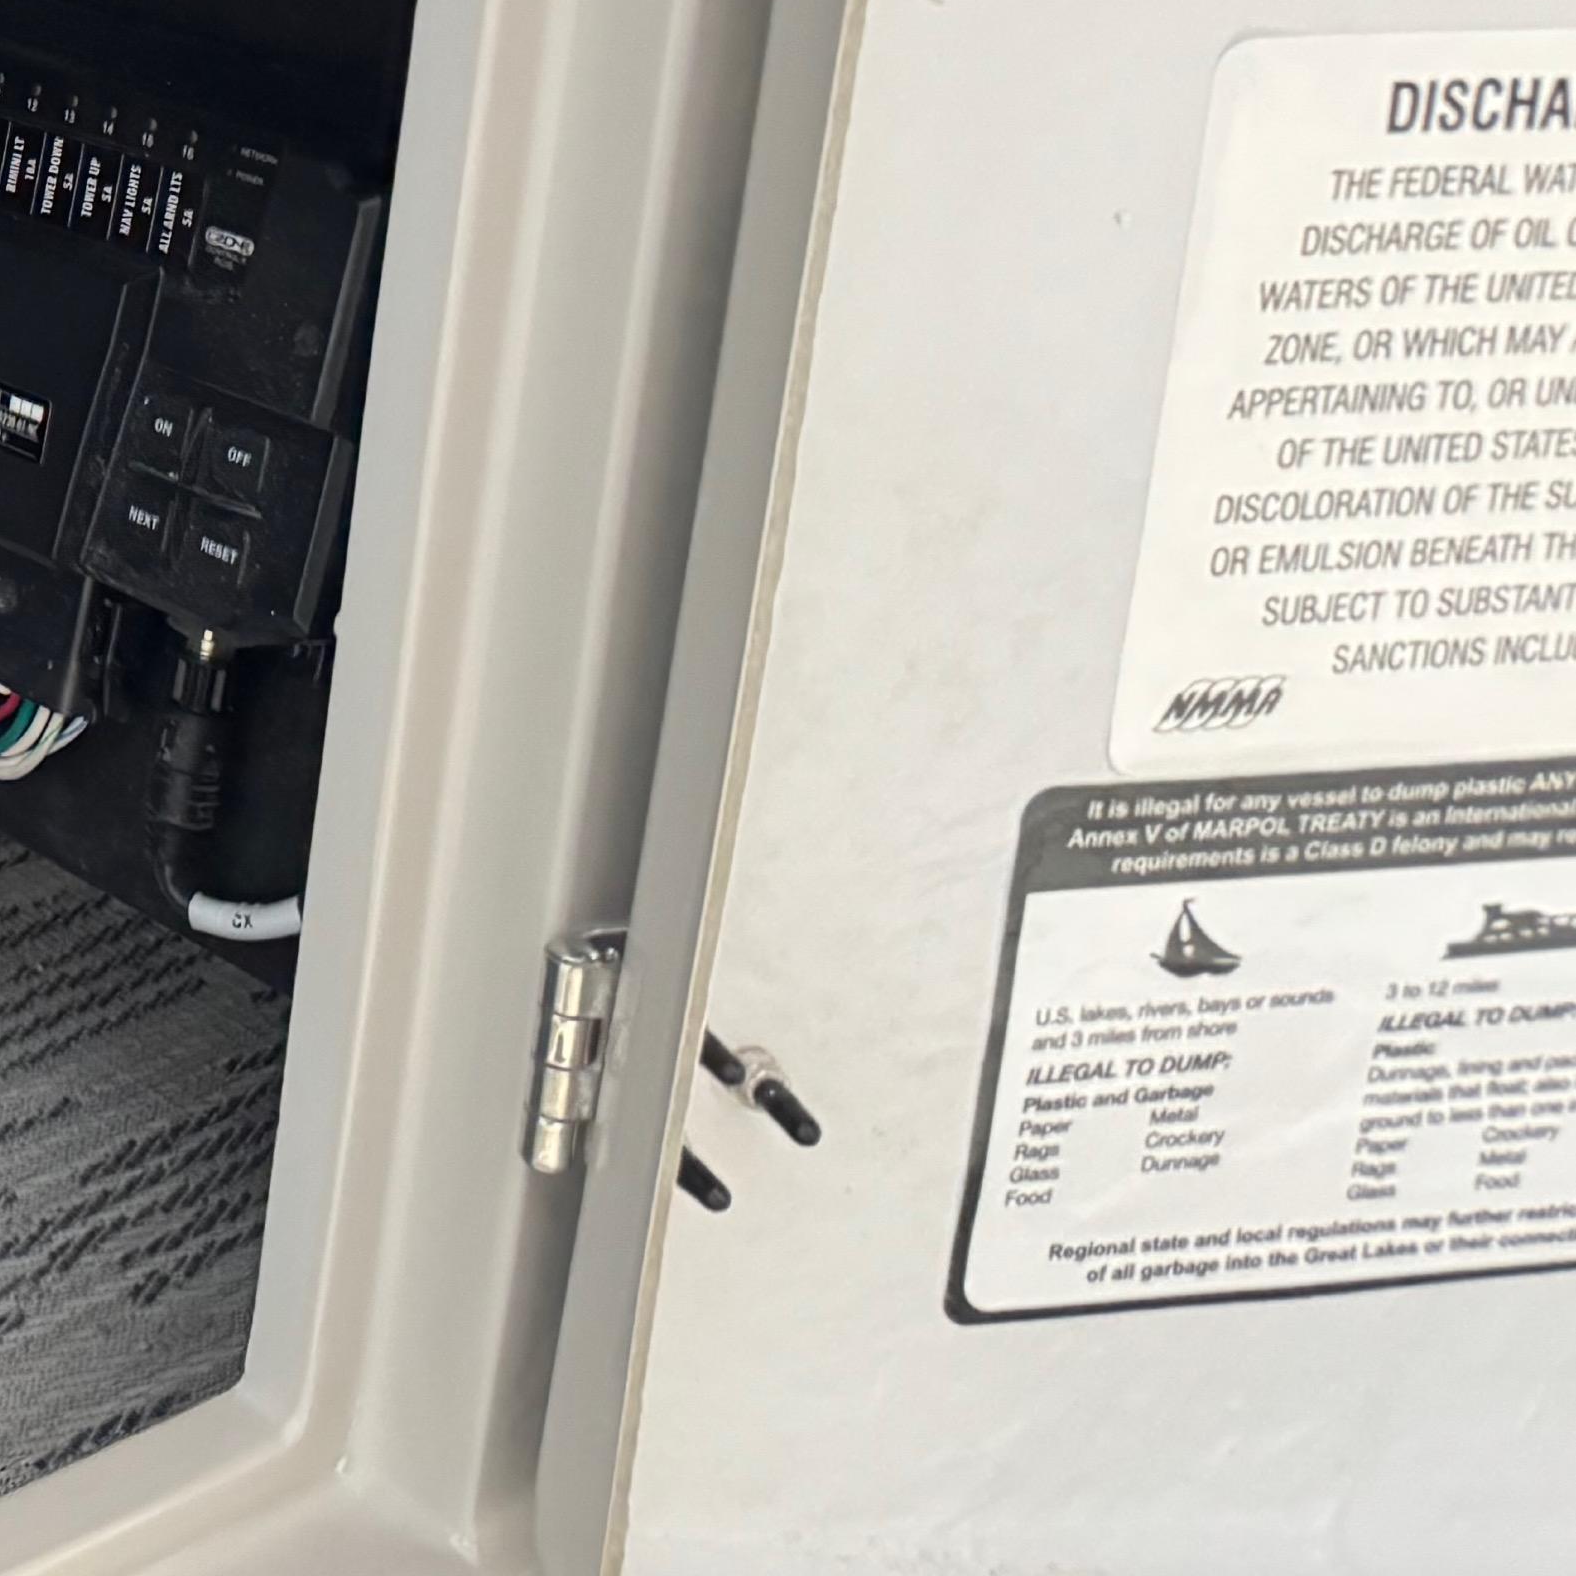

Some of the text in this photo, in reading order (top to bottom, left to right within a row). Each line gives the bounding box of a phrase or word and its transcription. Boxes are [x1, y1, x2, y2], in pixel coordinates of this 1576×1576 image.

[14, 135, 25, 153] LT
[40, 135, 64, 215] TOWER DOWN
[80, 156, 101, 218] TOWER UP
[1331, 167, 1383, 201] THE
[1388, 164, 1513, 200] FEDERAL
[118, 164, 142, 237] NAV LIGHTS
[158, 227, 173, 255] ALL
[169, 171, 183, 195] LTS
[1300, 217, 1558, 256] DISCHARGE OF OIL
[1259, 276, 1373, 312] WATERS
[1380, 274, 1416, 307] OF
[1424, 273, 1478, 304] THE
[1264, 323, 1566, 366] ZONE, OR WHICH MAY
[1227, 377, 1527, 420] APPERTAINING TO, OR
[154, 417, 173, 437] ON
[227, 446, 252, 467] OFF
[1276, 431, 1483, 470] OF THE UNITED
[128, 505, 160, 530] NEXT
[1213, 480, 1540, 526] DISCOLORATION OF THE
[200, 535, 238, 565] RESET
[1210, 533, 1533, 578] OR EMULSION BENEATH
[1261, 581, 1576, 627] SUBJECT TO SUBSTANT
[1331, 636, 1487, 675] SANCTIONS
[1088, 799, 1102, 820] It
[1108, 798, 1129, 819] is
[1134, 794, 1200, 821] illegal
[1204, 792, 1237, 813] for
[1240, 794, 1283, 814] any
[1287, 785, 1358, 809] vessel
[1361, 785, 1384, 803] to
[1387, 781, 1448, 805] dump
[1452, 776, 1527, 801] plastic
[1067, 809, 1442, 850] Annex V of MARPOL TREATY is an
[1111, 846, 1255, 876] requirements
[1260, 845, 1281, 864] is
[1285, 846, 1300, 863] a
[1304, 837, 1365, 861] Class
[1369, 835, 1388, 857] D
[1392, 834, 1460, 858] felony
[1462, 829, 1506, 851] and
[1036, 989, 1335, 1026] U.S. lakes, rivers, bays or sounds
[1377, 1009, 1466, 1033] ILLEGAL
[1032, 1020, 1238, 1052] and 3 miles from shore
[1026, 1060, 1117, 1086] ILLEGAL
[1125, 1058, 1155, 1076] TO
[1023, 1083, 1215, 1114] Plastic and Garbage
[1149, 1106, 1200, 1124] Metal
[1018, 1120, 1072, 1140] Paper
[1145, 1128, 1225, 1150] Crockery
[1014, 1142, 1060, 1162] Rags
[1141, 1152, 1221, 1174] Dunnage
[1009, 1165, 1060, 1184] Glass
[1004, 1188, 1053, 1208] Food
[1048, 1239, 1137, 1262] Regional
[1141, 1235, 1190, 1253] state
[1194, 1228, 1231, 1247] and
[1236, 1224, 1282, 1244] local
[1287, 1218, 1397, 1242] regulations
[1086, 1265, 1108, 1283] of
[1111, 1263, 1135, 1281] all
[1140, 1257, 1220, 1282] garbage
[1225, 1253, 1262, 1272] into
[1269, 1250, 1300, 1266] the
[1304, 1245, 1358, 1265] Great
[1363, 1242, 1419, 1260] Lakes
